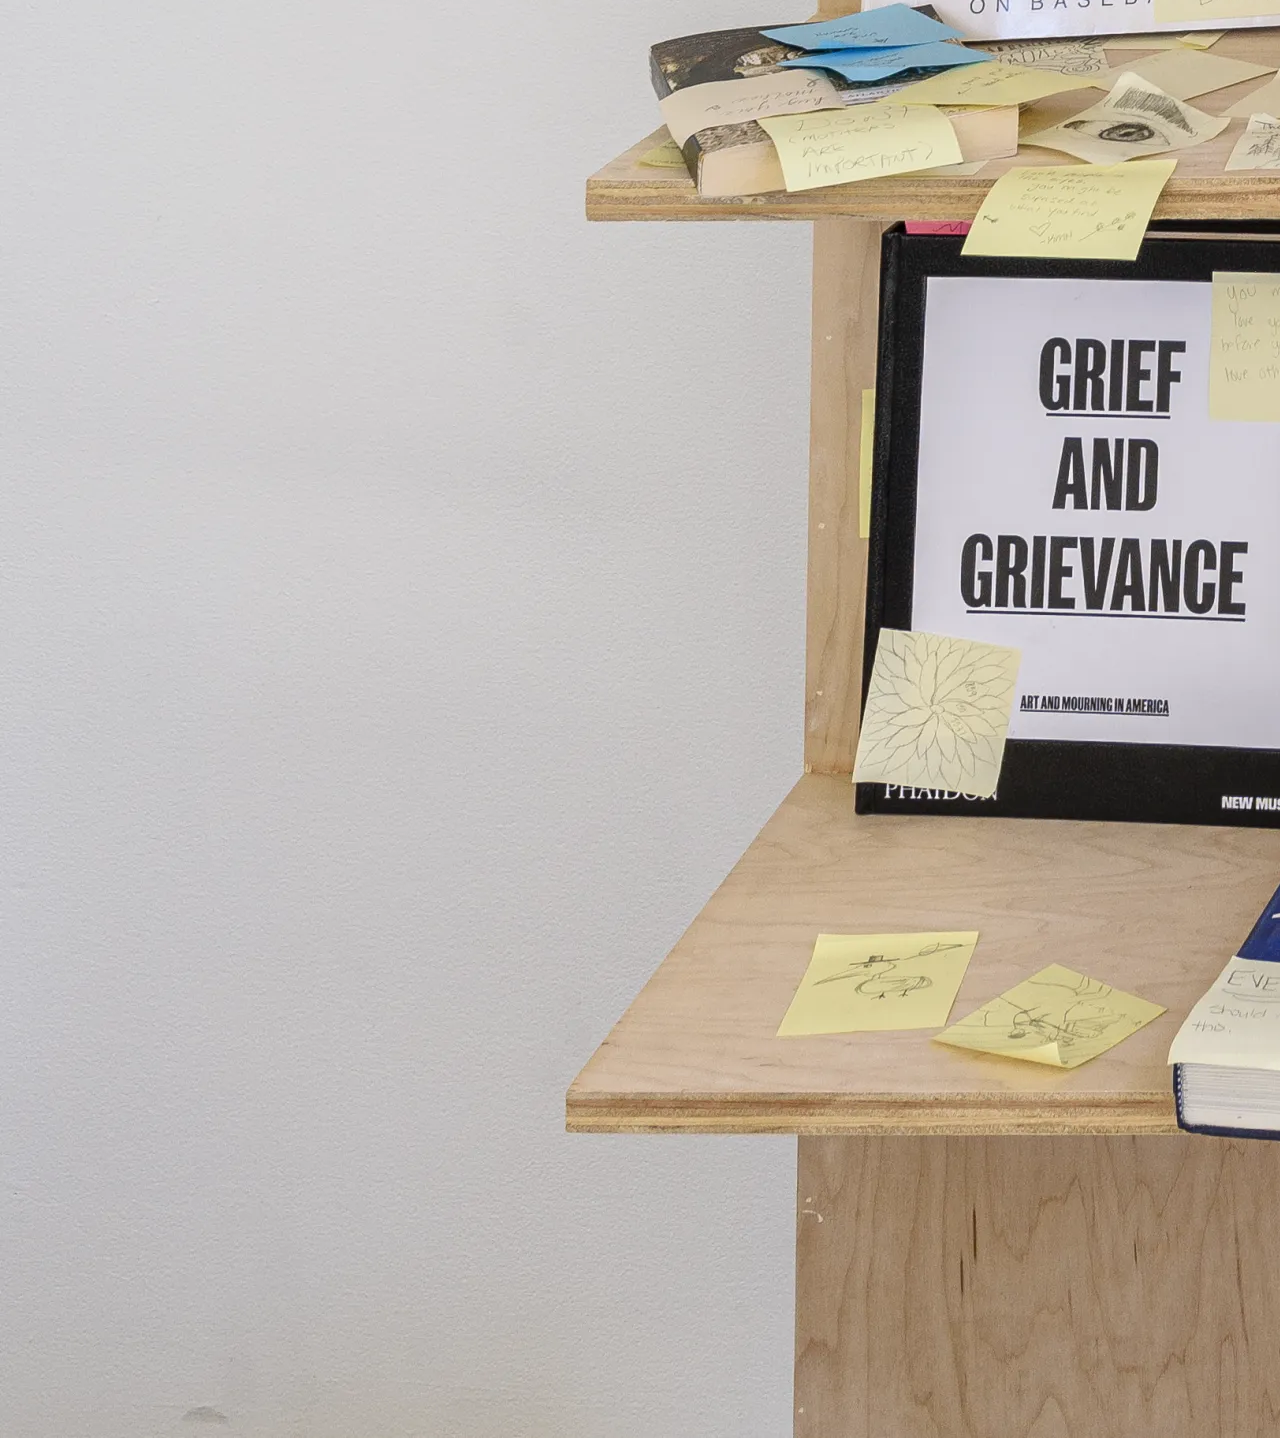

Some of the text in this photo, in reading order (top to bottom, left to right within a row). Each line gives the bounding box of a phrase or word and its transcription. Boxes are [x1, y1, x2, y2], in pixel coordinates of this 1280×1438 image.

[1038, 336, 1186, 412] GRIEF
[1052, 436, 1159, 511] AND
[960, 533, 1249, 614] GRIEVANCE
[1020, 695, 1170, 716] ART AND MOURNING IN AMERICA
[1221, 796, 1254, 810] NEW
